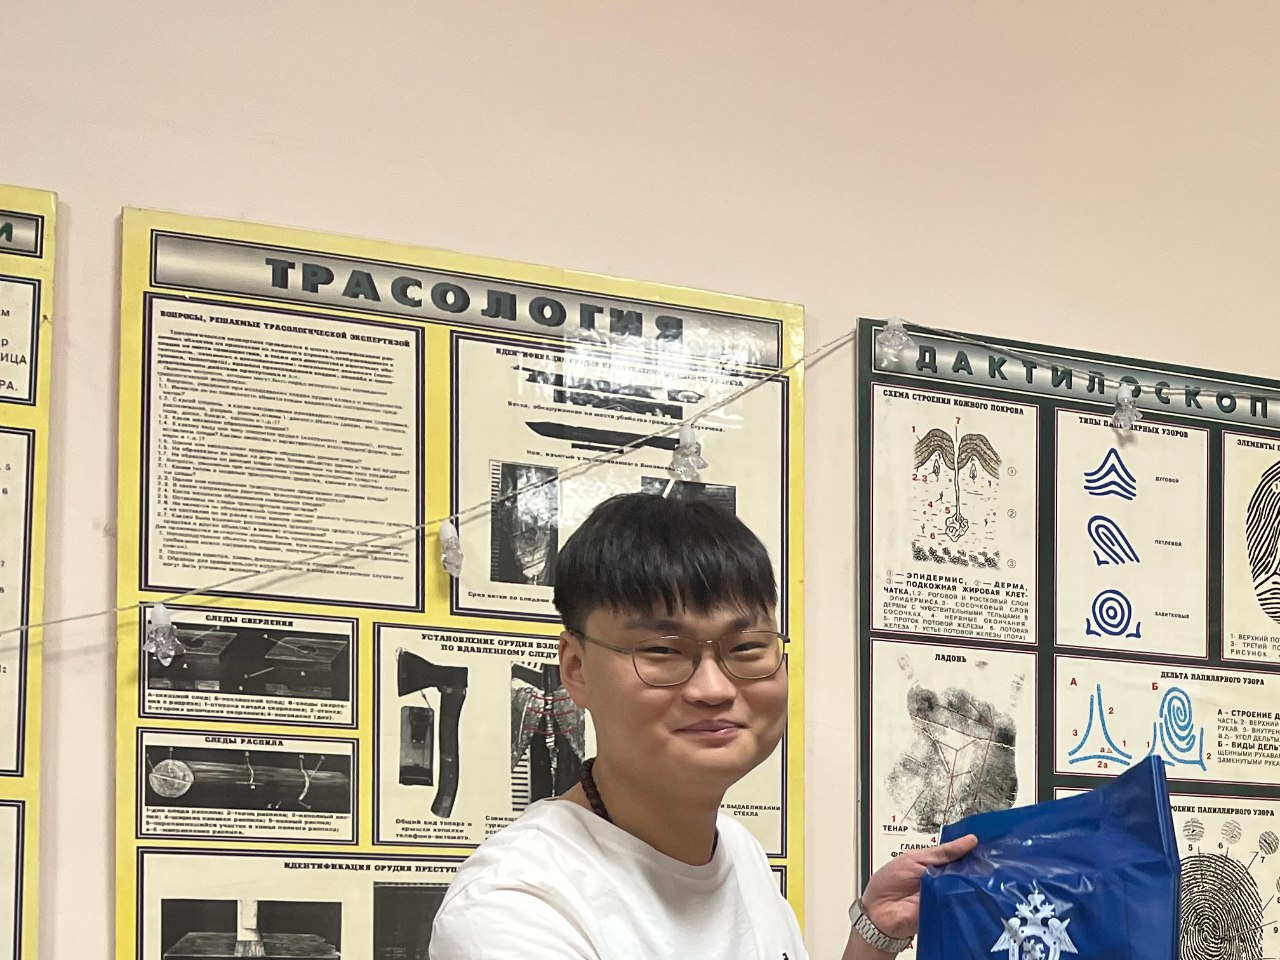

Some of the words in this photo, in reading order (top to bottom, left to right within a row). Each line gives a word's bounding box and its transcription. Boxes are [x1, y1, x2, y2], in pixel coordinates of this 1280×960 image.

[265, 257, 684, 340] ТРАСОЛОГИЯ
[160, 310, 206, 322] ВОПРОСЫ,
[209, 316, 260, 327] РЕШАЕМЫЕ
[263, 322, 347, 338] ТРАСОЛОГИЧЕСКОЙ
[349, 334, 410, 347] ЭКСПЕРТИЗОЙ
[883, 389, 909, 399] СХЕМА
[912, 393, 951, 404] СТРОЕНИЯ
[953, 399, 988, 409] КОЖНОГО
[990, 404, 1023, 414] ПОКРОВА
[1079, 416, 1101, 426] ТИПЫ
[1162, 428, 1188, 438] УЗОРОВ
[1237, 439, 1275, 450] ЭЛЕМЕНТЫ
[906, 572, 967, 584] ЭПИДЕРМИС,
[993, 581, 1027, 591] ДЕРМА,
[906, 580, 956, 591] ПОДКОЖНАЯ
[962, 586, 1000, 595] ЖИРОВАЯ
[1005, 590, 1027, 598] КЛЕТ-
[927, 591, 957, 599] РОГОВОЙ
[969, 595, 1007, 604] РОСТКОВЫЙ
[955, 601, 1003, 611] СОСОЧКОВЫЙ
[919, 605, 983, 615] ЧУВСТВИТЕЛЬНЫМИ
[987, 611, 1020, 619] ТЕЛЬЦАМИ
[205, 614, 237, 622] СЛЕДЫ
[241, 617, 293, 626] СВЕРЛЕНИЯ
[944, 614, 977, 622] НЕРВНЫЕ
[943, 627, 973, 635] ПОТОВОЙ
[421, 633, 495, 645] УСТАНОВЛЕНИЕ
[497, 639, 533, 647] ОРУДИЯ
[1238, 633, 1268, 641] ВЕРХНИЙ
[1242, 641, 1267, 649] ТРЕТИЙ
[456, 645, 525, 656] ВДАВЛЕННОМУ
[528, 650, 557, 658] СЛЕДУ
[934, 653, 967, 663] ЛАДОНЬ
[1160, 671, 1188, 679] ДЕЛЬТА
[1190, 673, 1241, 683] ПАПИЛЯРНОГО
[1242, 677, 1264, 685] УЗОРА
[1231, 709, 1272, 718] СТРОЕНИЕ
[204, 736, 237, 744] СЛЕДЫ
[240, 738, 284, 746] РАСПИЛА
[1231, 741, 1255, 749] ВИДЫ
[1217, 756, 1262, 764] ЗАМКНУТЫМИ
[1197, 806, 1251, 815] ПАПИЛЛЯРНОГО
[283, 862, 371, 870] ИДЕНТИФИКАЦИЯ
[374, 864, 411, 872] ОРУДИЯ
